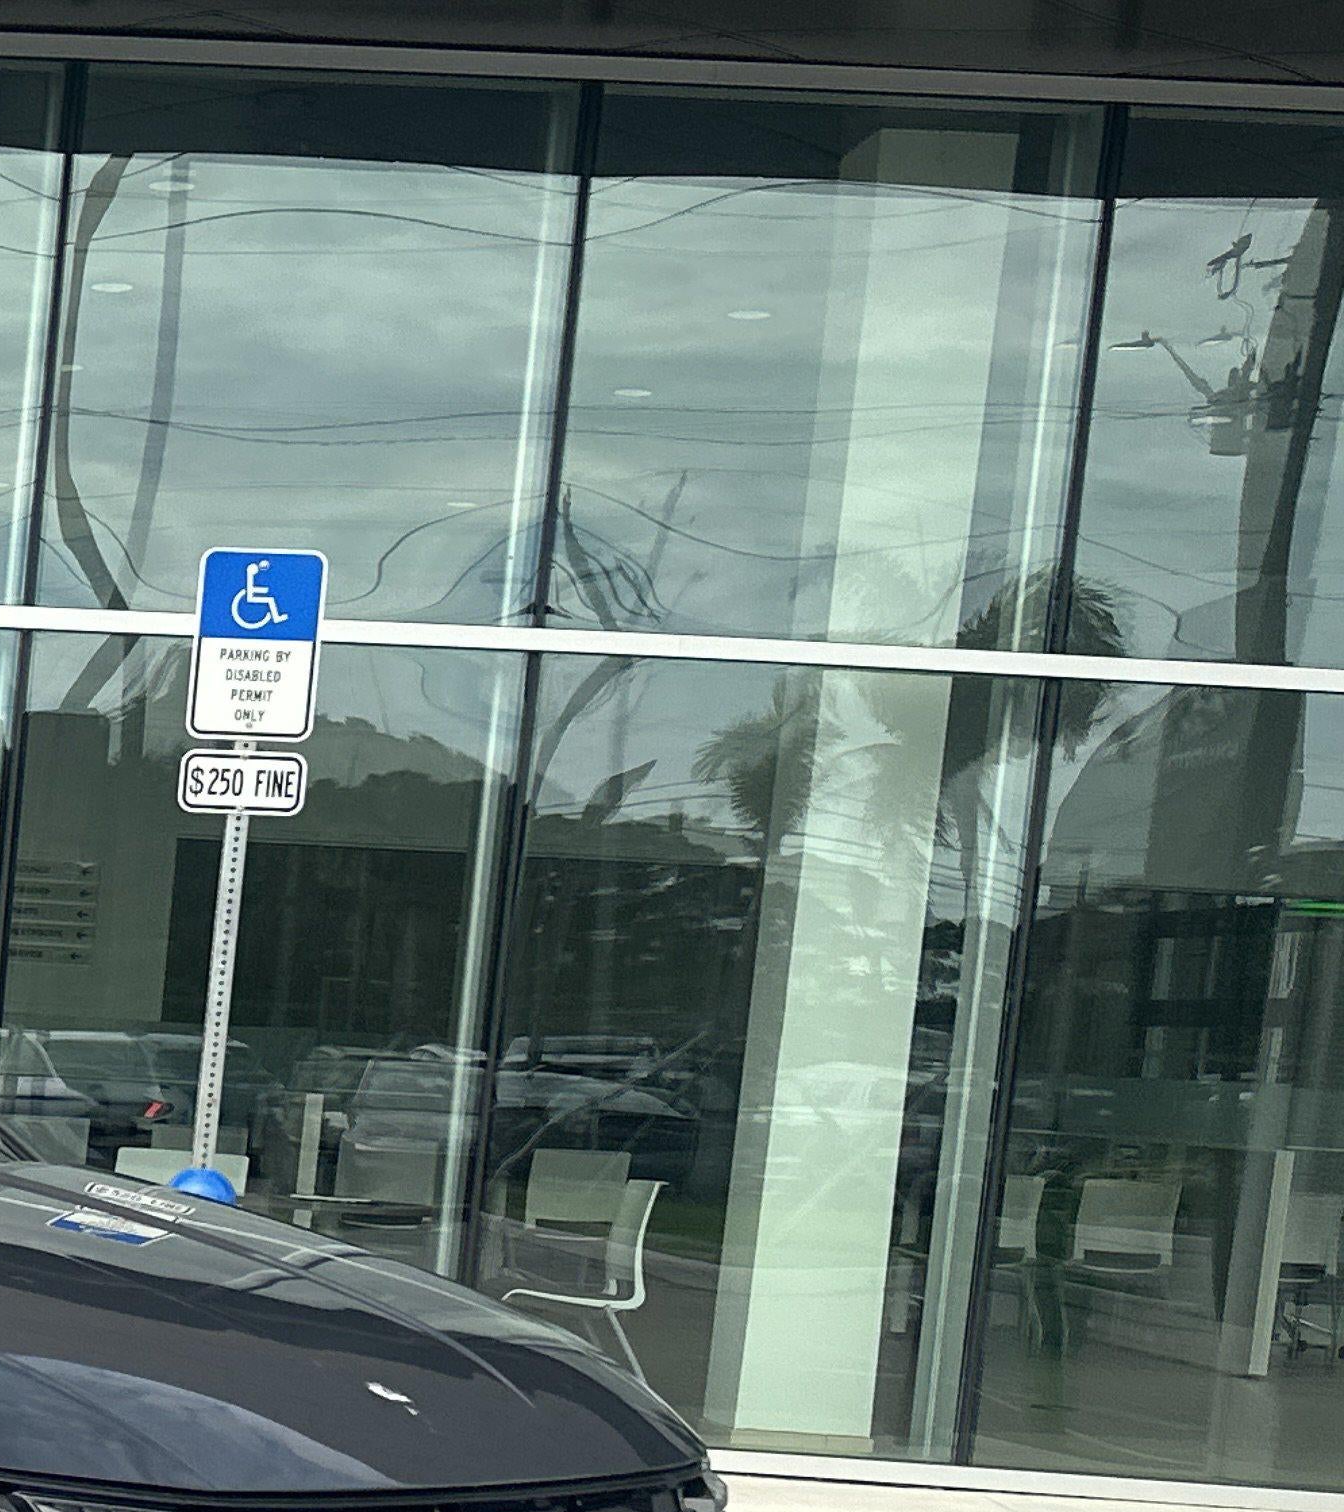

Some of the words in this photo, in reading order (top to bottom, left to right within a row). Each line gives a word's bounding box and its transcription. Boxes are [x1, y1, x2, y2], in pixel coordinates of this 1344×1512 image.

[220, 648, 270, 662] PARKING
[276, 650, 291, 663] BY
[226, 668, 282, 682] DISABLED
[230, 689, 273, 702] PERMIT
[234, 709, 265, 722] ONLY
[189, 765, 244, 797] $250
[255, 770, 296, 798] FINE
